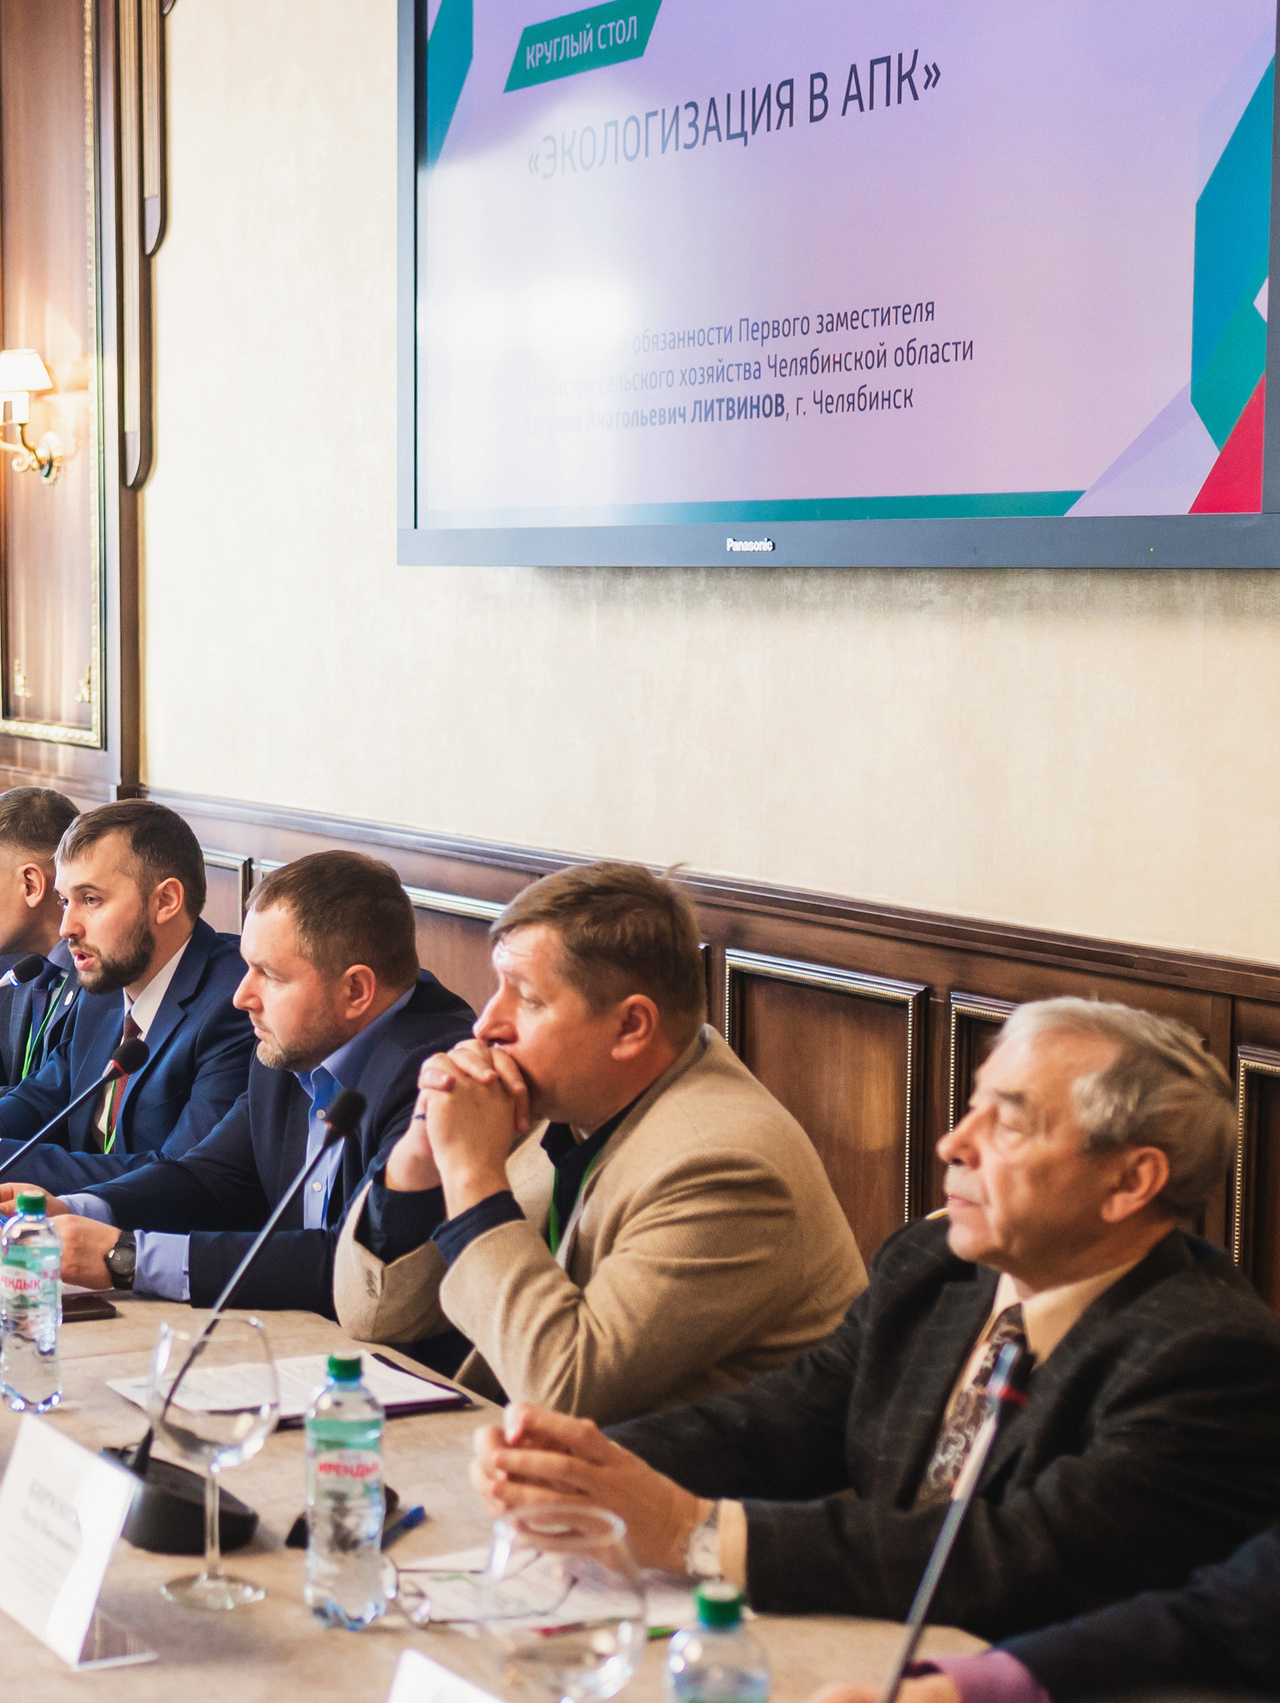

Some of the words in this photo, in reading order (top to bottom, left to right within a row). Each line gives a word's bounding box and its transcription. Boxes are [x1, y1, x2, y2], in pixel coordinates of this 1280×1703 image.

[525, 23, 593, 70] КРУГЛЫЙ
[597, 15, 638, 50] СТОЛ
[527, 78, 795, 180] «ЭКОЛОГИЗАЦИЯ
[808, 71, 829, 124] В
[840, 48, 941, 117] АПК»
[632, 324, 733, 354] обязанности
[738, 315, 811, 347] Первого
[815, 301, 936, 334] заместителя
[679, 358, 761, 388] хозяйства
[767, 340, 888, 379] Челябинской
[893, 337, 974, 368] области
[690, 392, 790, 424] ЛИТВИНОВ,
[795, 396, 807, 416] г.
[812, 384, 915, 415] Челябинск
[726, 537, 774, 552] Panasonic
